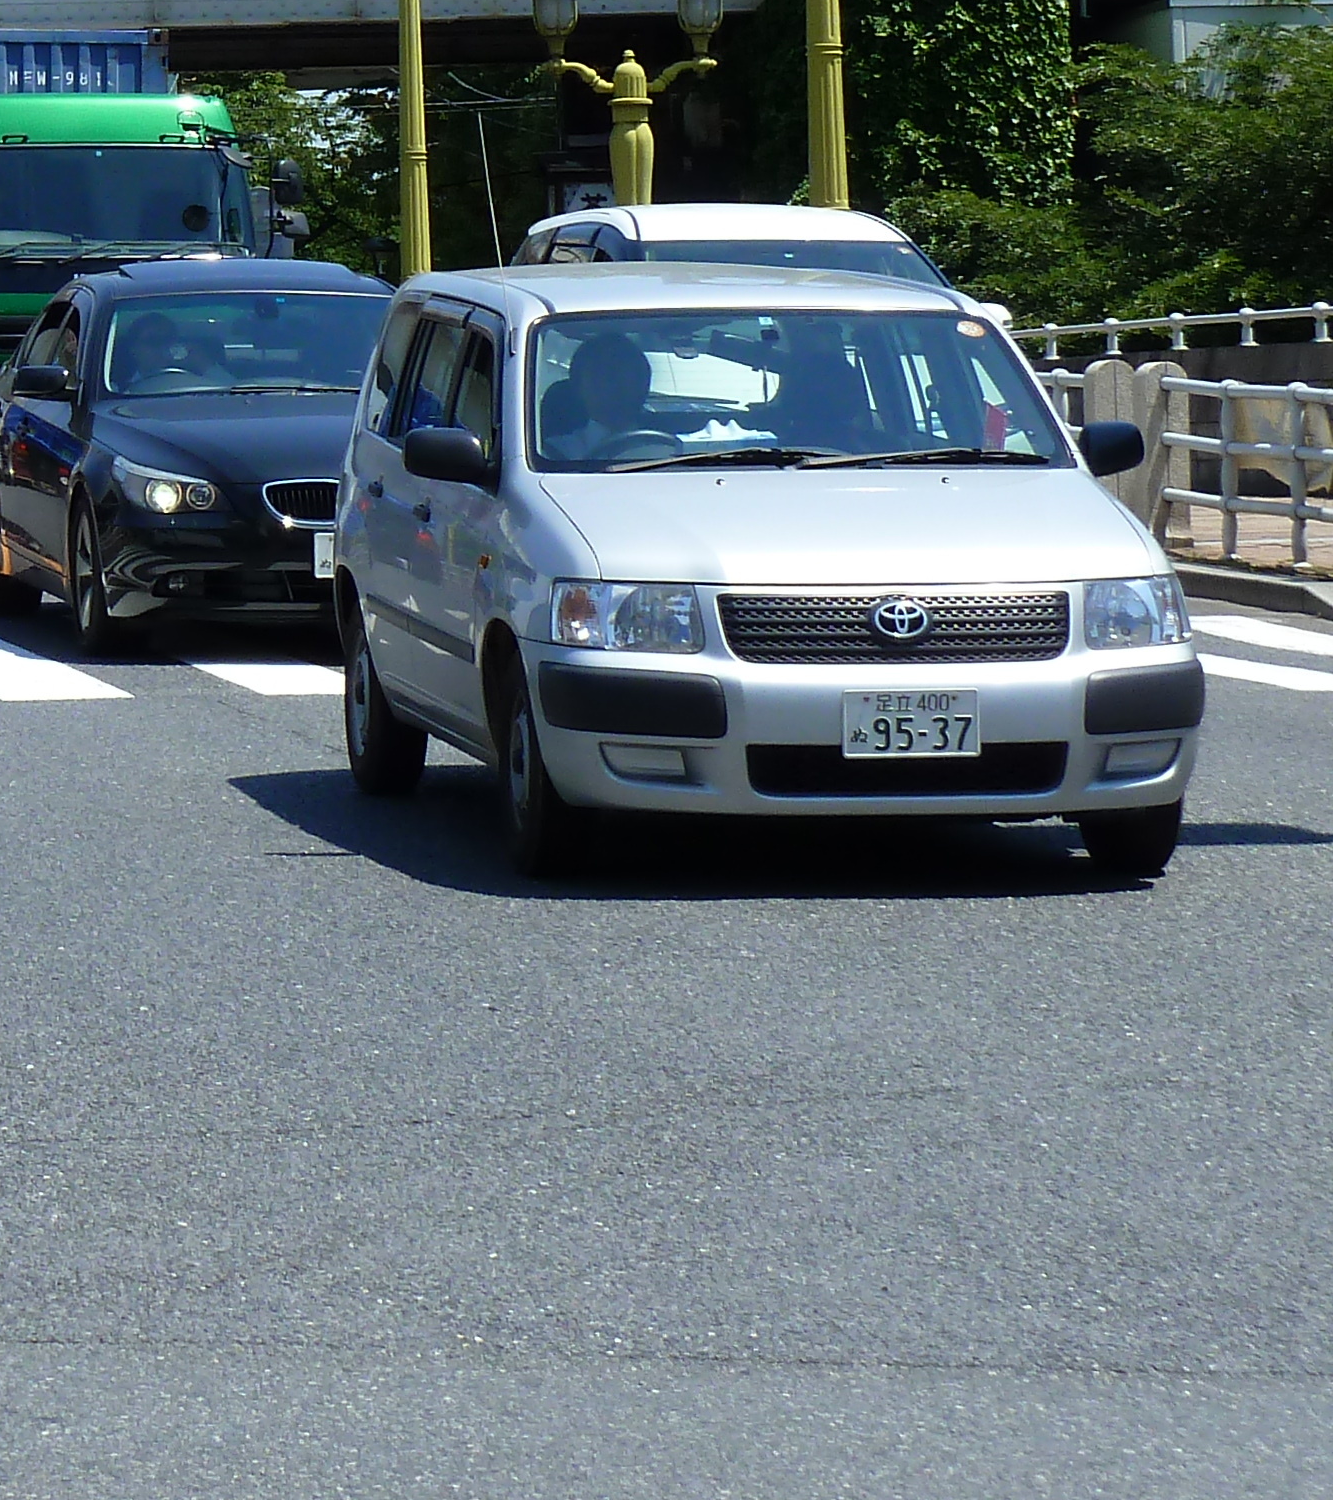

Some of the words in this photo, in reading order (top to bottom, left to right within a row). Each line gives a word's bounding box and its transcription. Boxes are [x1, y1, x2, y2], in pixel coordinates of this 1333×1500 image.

[876, 694, 913, 712] 足立
[917, 694, 950, 711] 400
[850, 726, 868, 743] ぬ
[873, 714, 973, 751] 95-37
